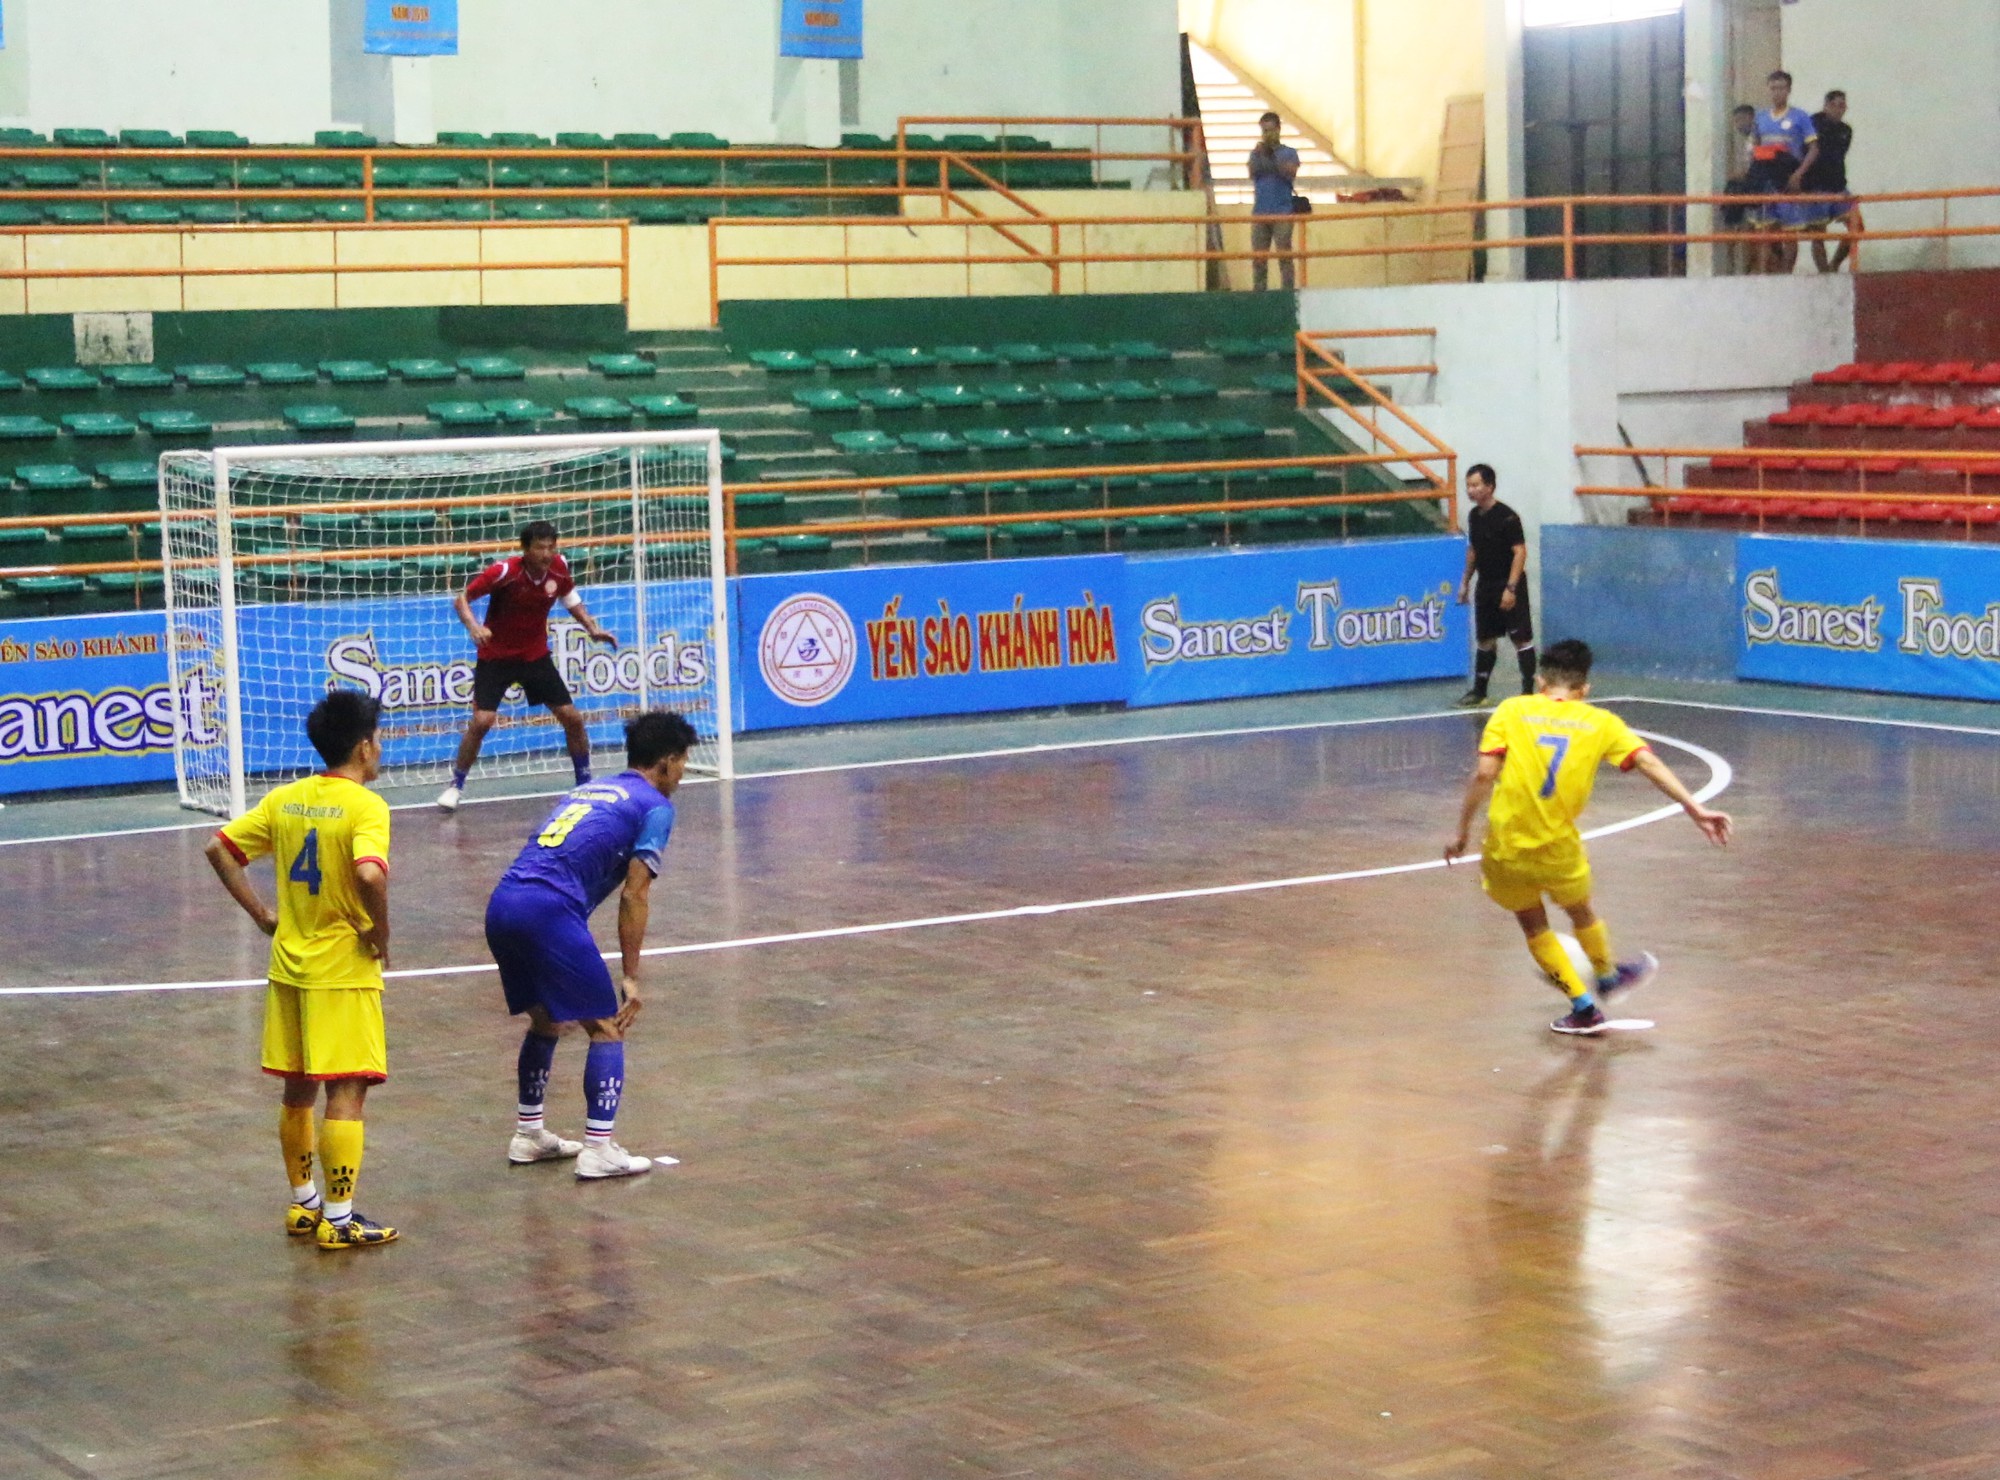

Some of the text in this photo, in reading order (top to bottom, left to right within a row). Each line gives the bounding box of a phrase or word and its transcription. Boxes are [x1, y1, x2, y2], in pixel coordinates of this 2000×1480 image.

[0, 635, 29, 663] ẾN
[35, 637, 77, 660] SÀO
[82, 632, 157, 658] KHÁNH
[866, 595, 918, 679] YẾN
[923, 599, 973, 676] SÀO
[977, 594, 1061, 672] KHÁNH
[1065, 589, 1117, 665] HÒA
[1142, 582, 1443, 666] Sanest Tourist
[1744, 571, 1883, 650] Sanest
[549, 618, 707, 693] Foods
[1537, 734, 1570, 798] 7
[289, 827, 322, 896] 4
